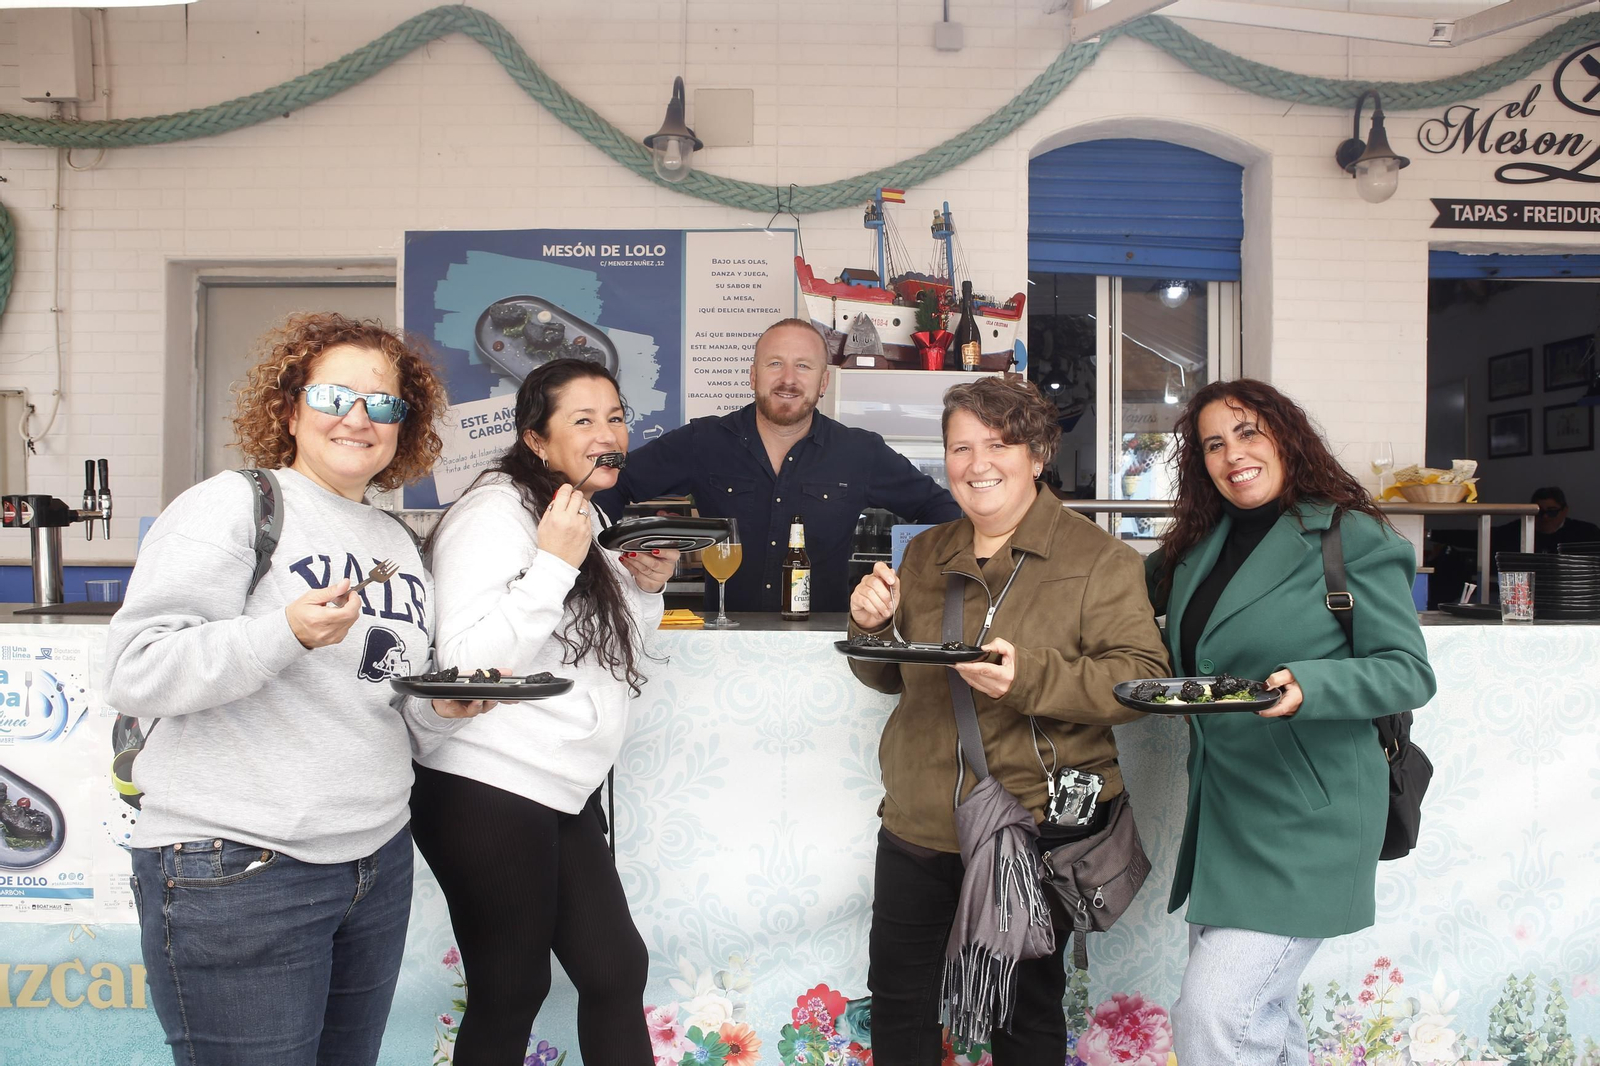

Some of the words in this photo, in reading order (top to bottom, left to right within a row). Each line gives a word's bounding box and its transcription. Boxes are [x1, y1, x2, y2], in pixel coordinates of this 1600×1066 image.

[1505, 84, 1541, 119] el
[1417, 105, 1593, 157] Meson
[1451, 204, 1508, 222] TAPAS
[1523, 206, 1600, 224] FREIDUR
[542, 242, 596, 257] MESÓN
[601, 245, 620, 256] DE
[625, 244, 666, 257] LOLO
[460, 413, 489, 429] ESTE
[443, 454, 468, 466] Bacalao
[469, 451, 477, 460] de
[446, 465, 461, 474] tinta
[463, 462, 470, 470] de
[0, 876, 13, 886] DE
[17, 876, 48, 886] LOLO
